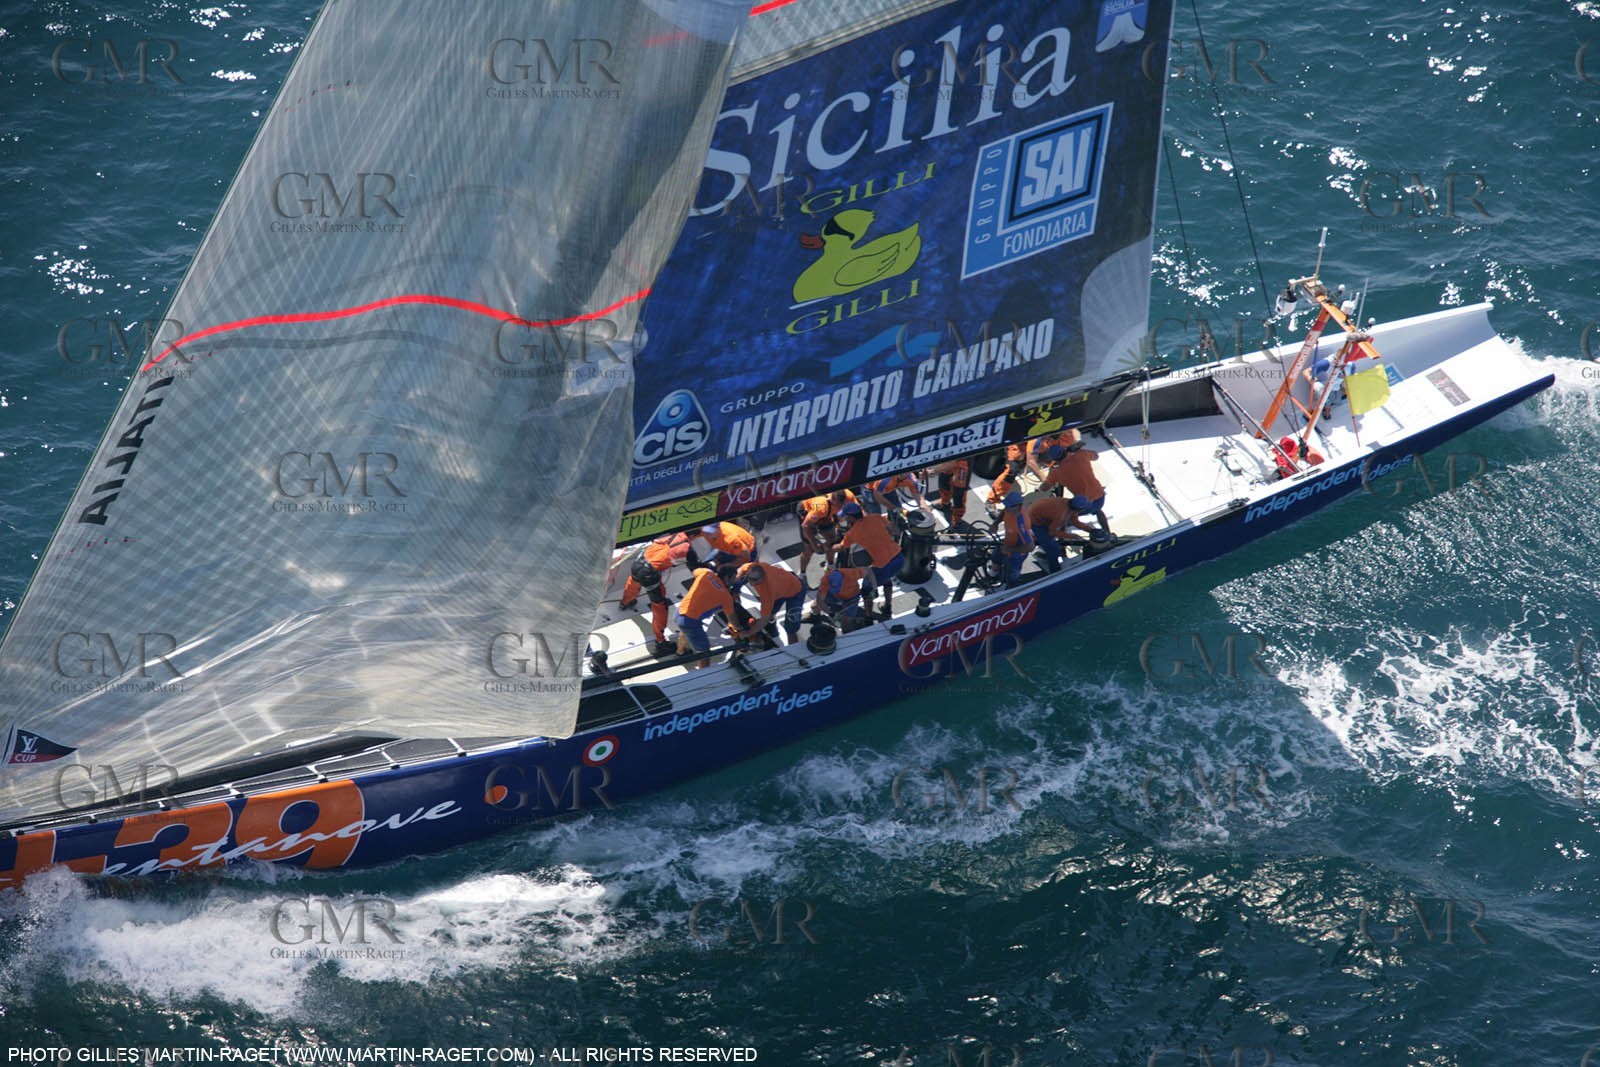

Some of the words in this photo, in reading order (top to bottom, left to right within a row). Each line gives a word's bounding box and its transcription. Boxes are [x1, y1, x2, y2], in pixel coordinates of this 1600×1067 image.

[687, 24, 1077, 217] Sicilia
[801, 162, 936, 214] GILLI
[1021, 127, 1092, 207] SAI
[975, 148, 1002, 244] GRUPPO
[1003, 211, 1087, 257] FONDIARIA
[786, 278, 919, 334] GILLI
[720, 382, 805, 414] GRUPPO
[727, 369, 904, 459] INTERPORTO
[913, 318, 1054, 399] CAMPANO
[634, 421, 704, 463] CIS
[653, 463, 682, 480] DEGLI
[685, 453, 719, 471] AFFARI
[723, 458, 849, 512] yamamay
[1244, 458, 1369, 524] independent
[619, 507, 669, 537] rpisa
[1110, 538, 1177, 569] GILLI
[909, 598, 1034, 665] yamamay
[643, 684, 781, 741] independent
[776, 684, 833, 716] ideas
[15, 753, 37, 763] CUP
